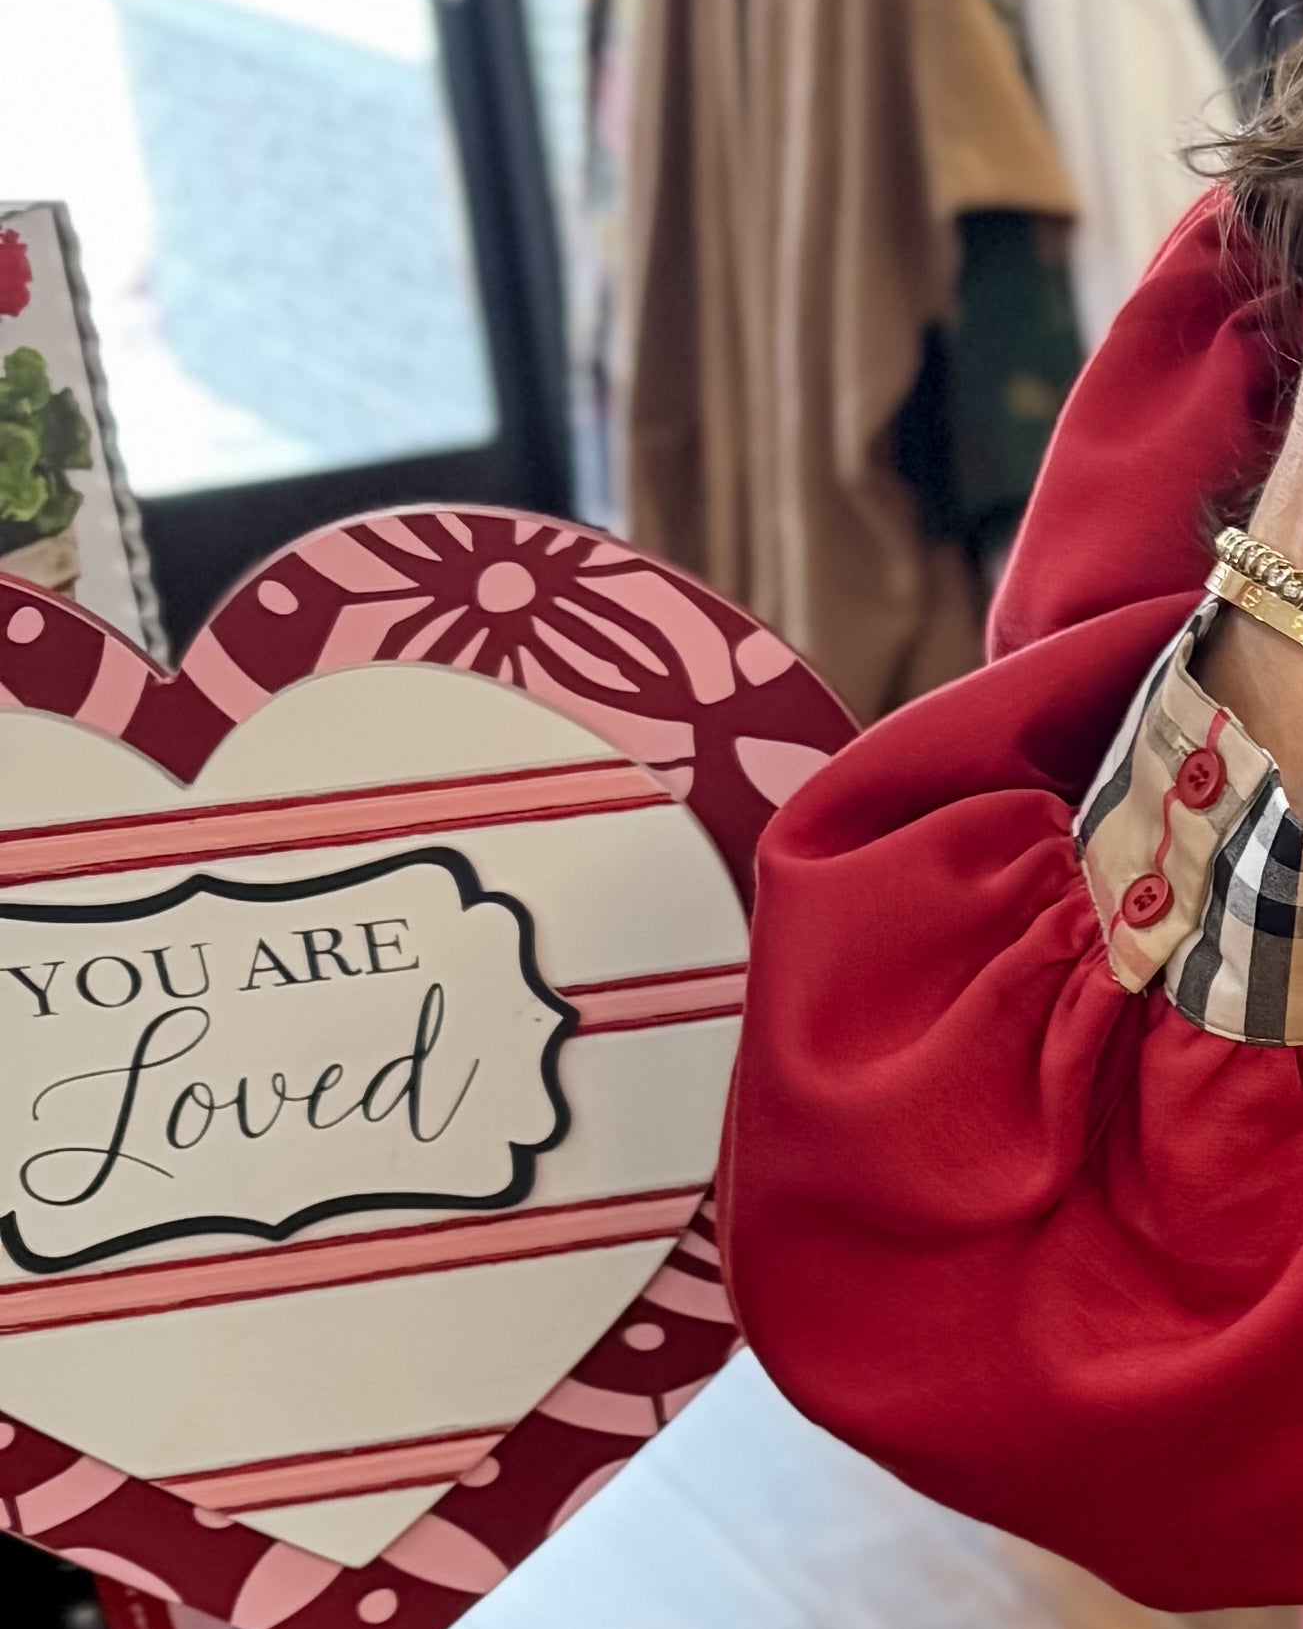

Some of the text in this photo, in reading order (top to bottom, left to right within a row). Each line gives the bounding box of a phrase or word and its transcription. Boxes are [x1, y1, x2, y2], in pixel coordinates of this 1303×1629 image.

[1, 918, 420, 1018] YOU ARE
[19, 982, 480, 1205] Loved
